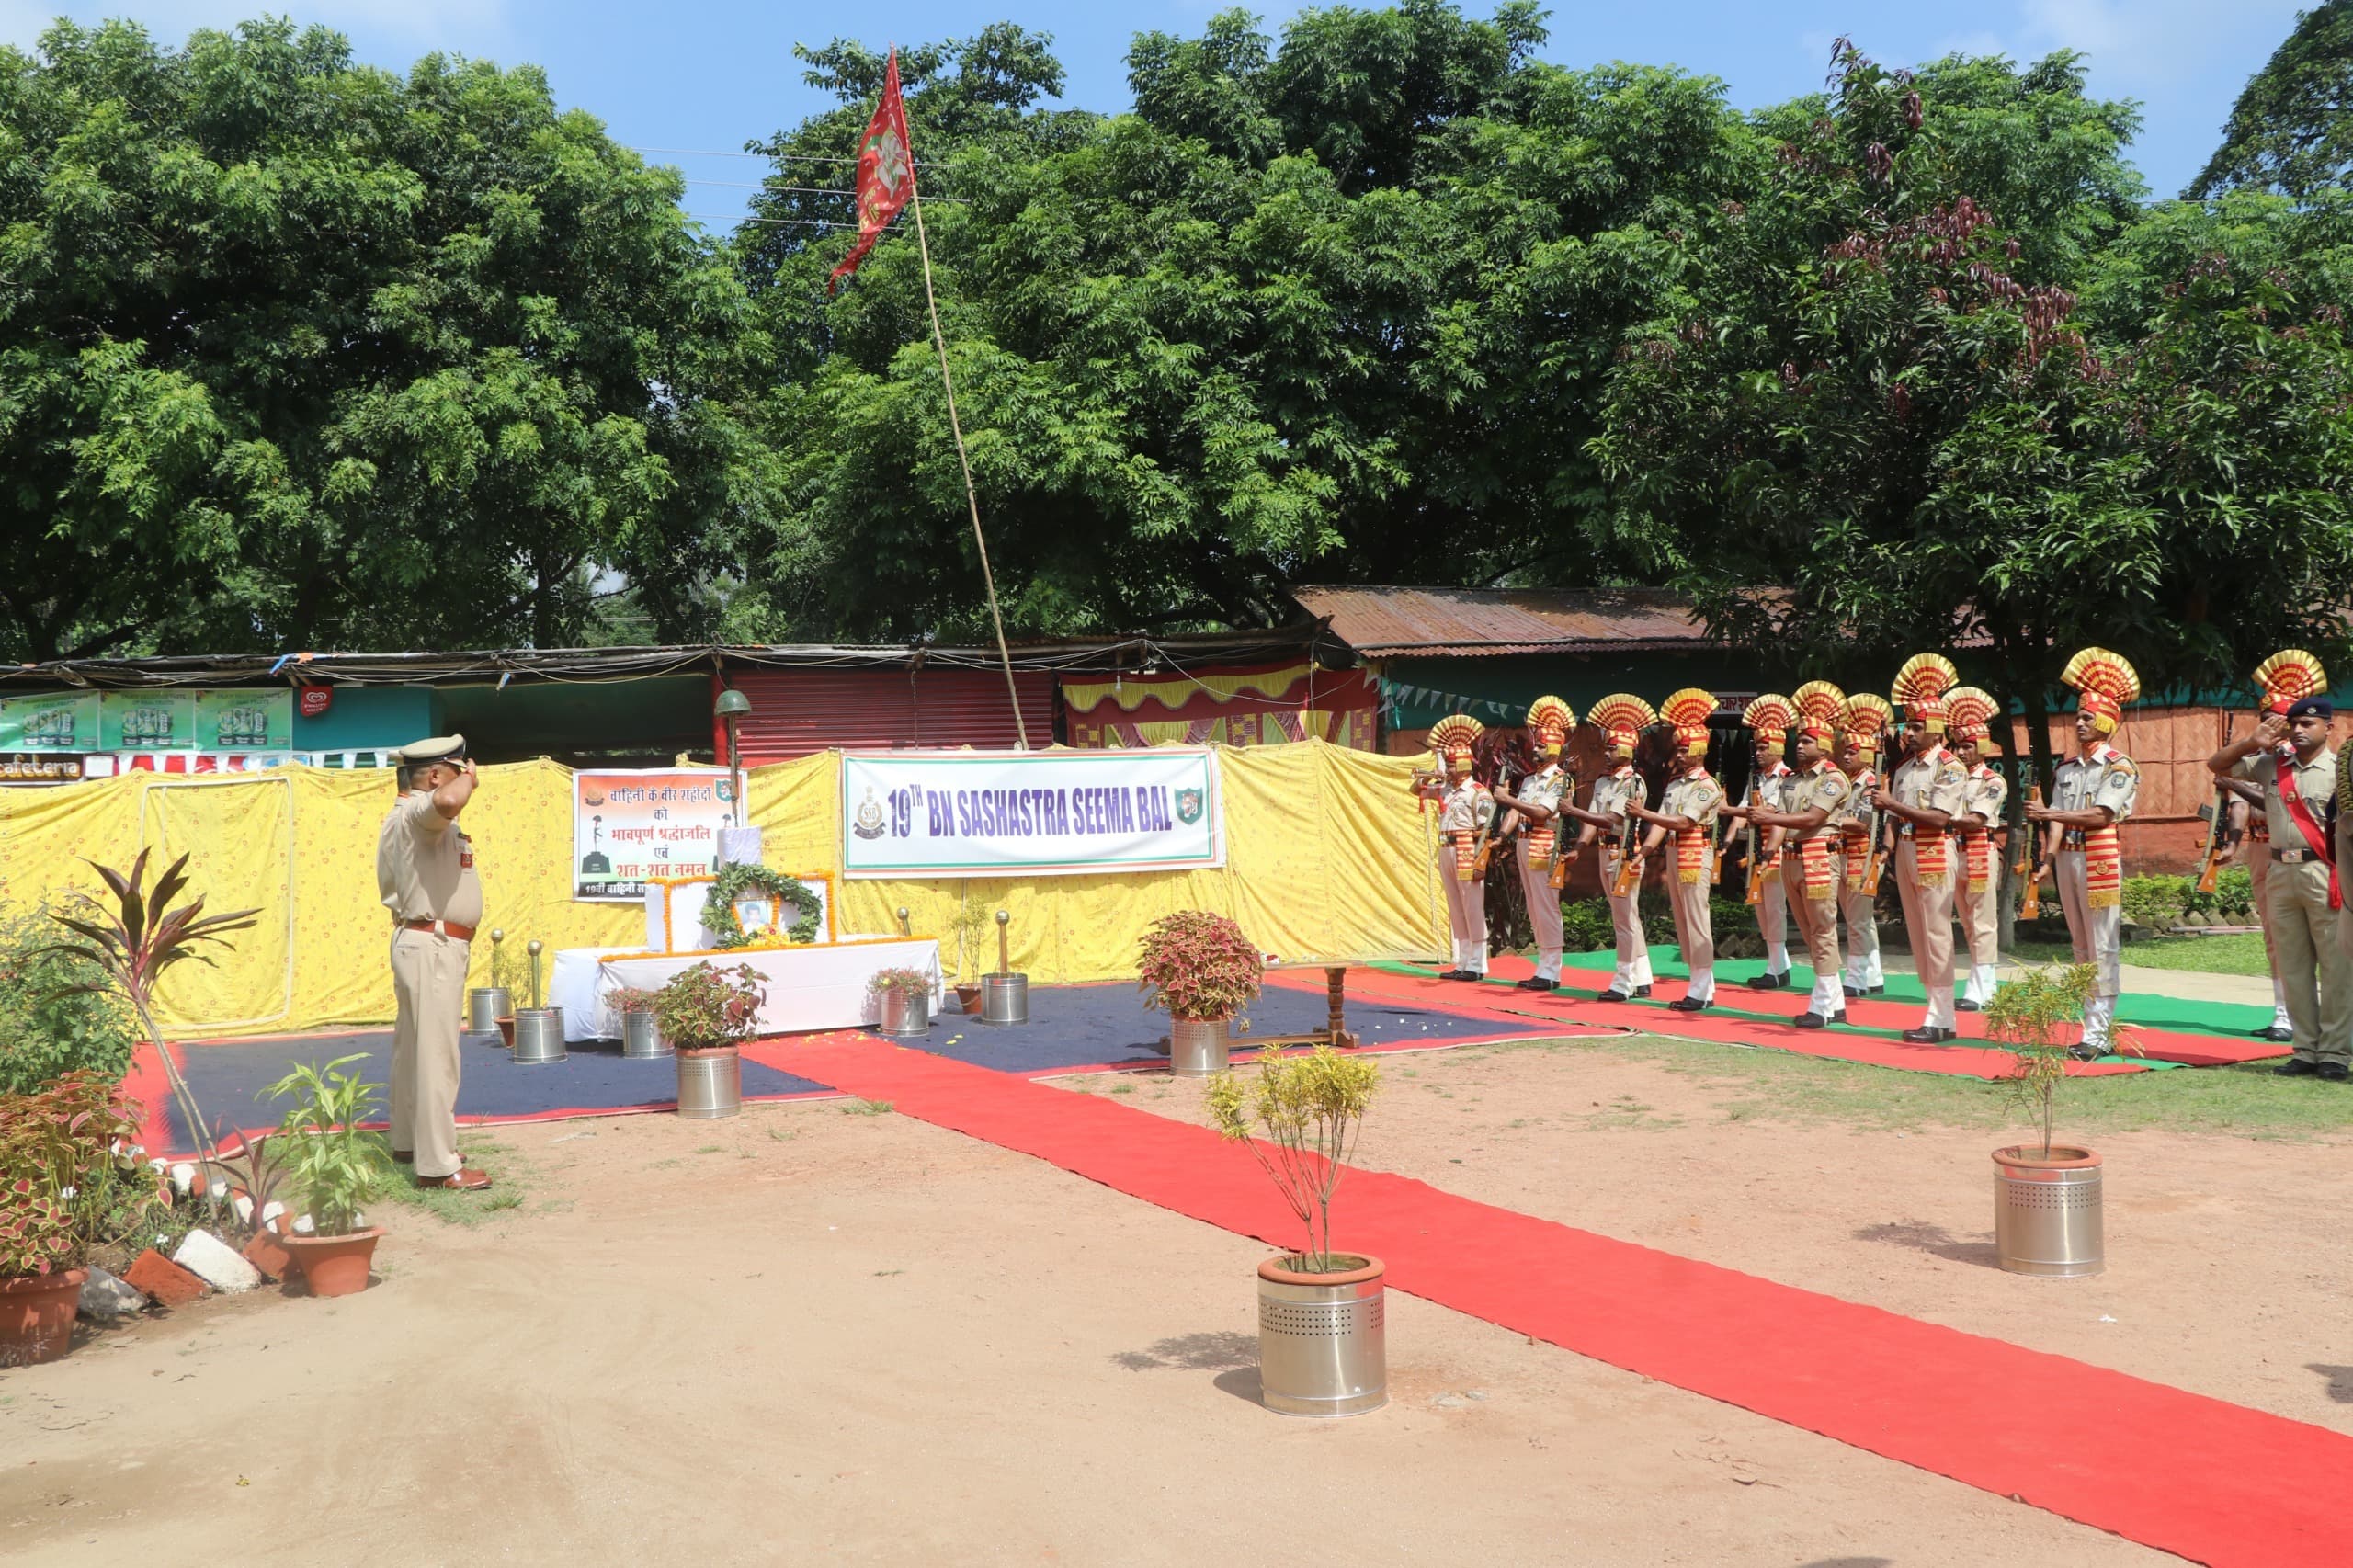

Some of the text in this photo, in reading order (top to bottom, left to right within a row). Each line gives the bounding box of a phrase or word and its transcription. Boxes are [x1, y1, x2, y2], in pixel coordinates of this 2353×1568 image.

[1717, 696, 1737, 711] चार
[610, 788, 644, 803] वाहिनी
[648, 787, 657, 801] के
[661, 787, 676, 801] वीर
[654, 807, 668, 821] को
[926, 790, 955, 836] BN
[957, 789, 1070, 837] SASHASTRA
[1072, 787, 1135, 835] SEEMA
[1136, 785, 1173, 832] BAL
[611, 826, 654, 845] भावपूर्ण
[654, 845, 669, 858] एवं
[675, 863, 707, 876] नमन
[607, 881, 635, 895] वाहिनी
